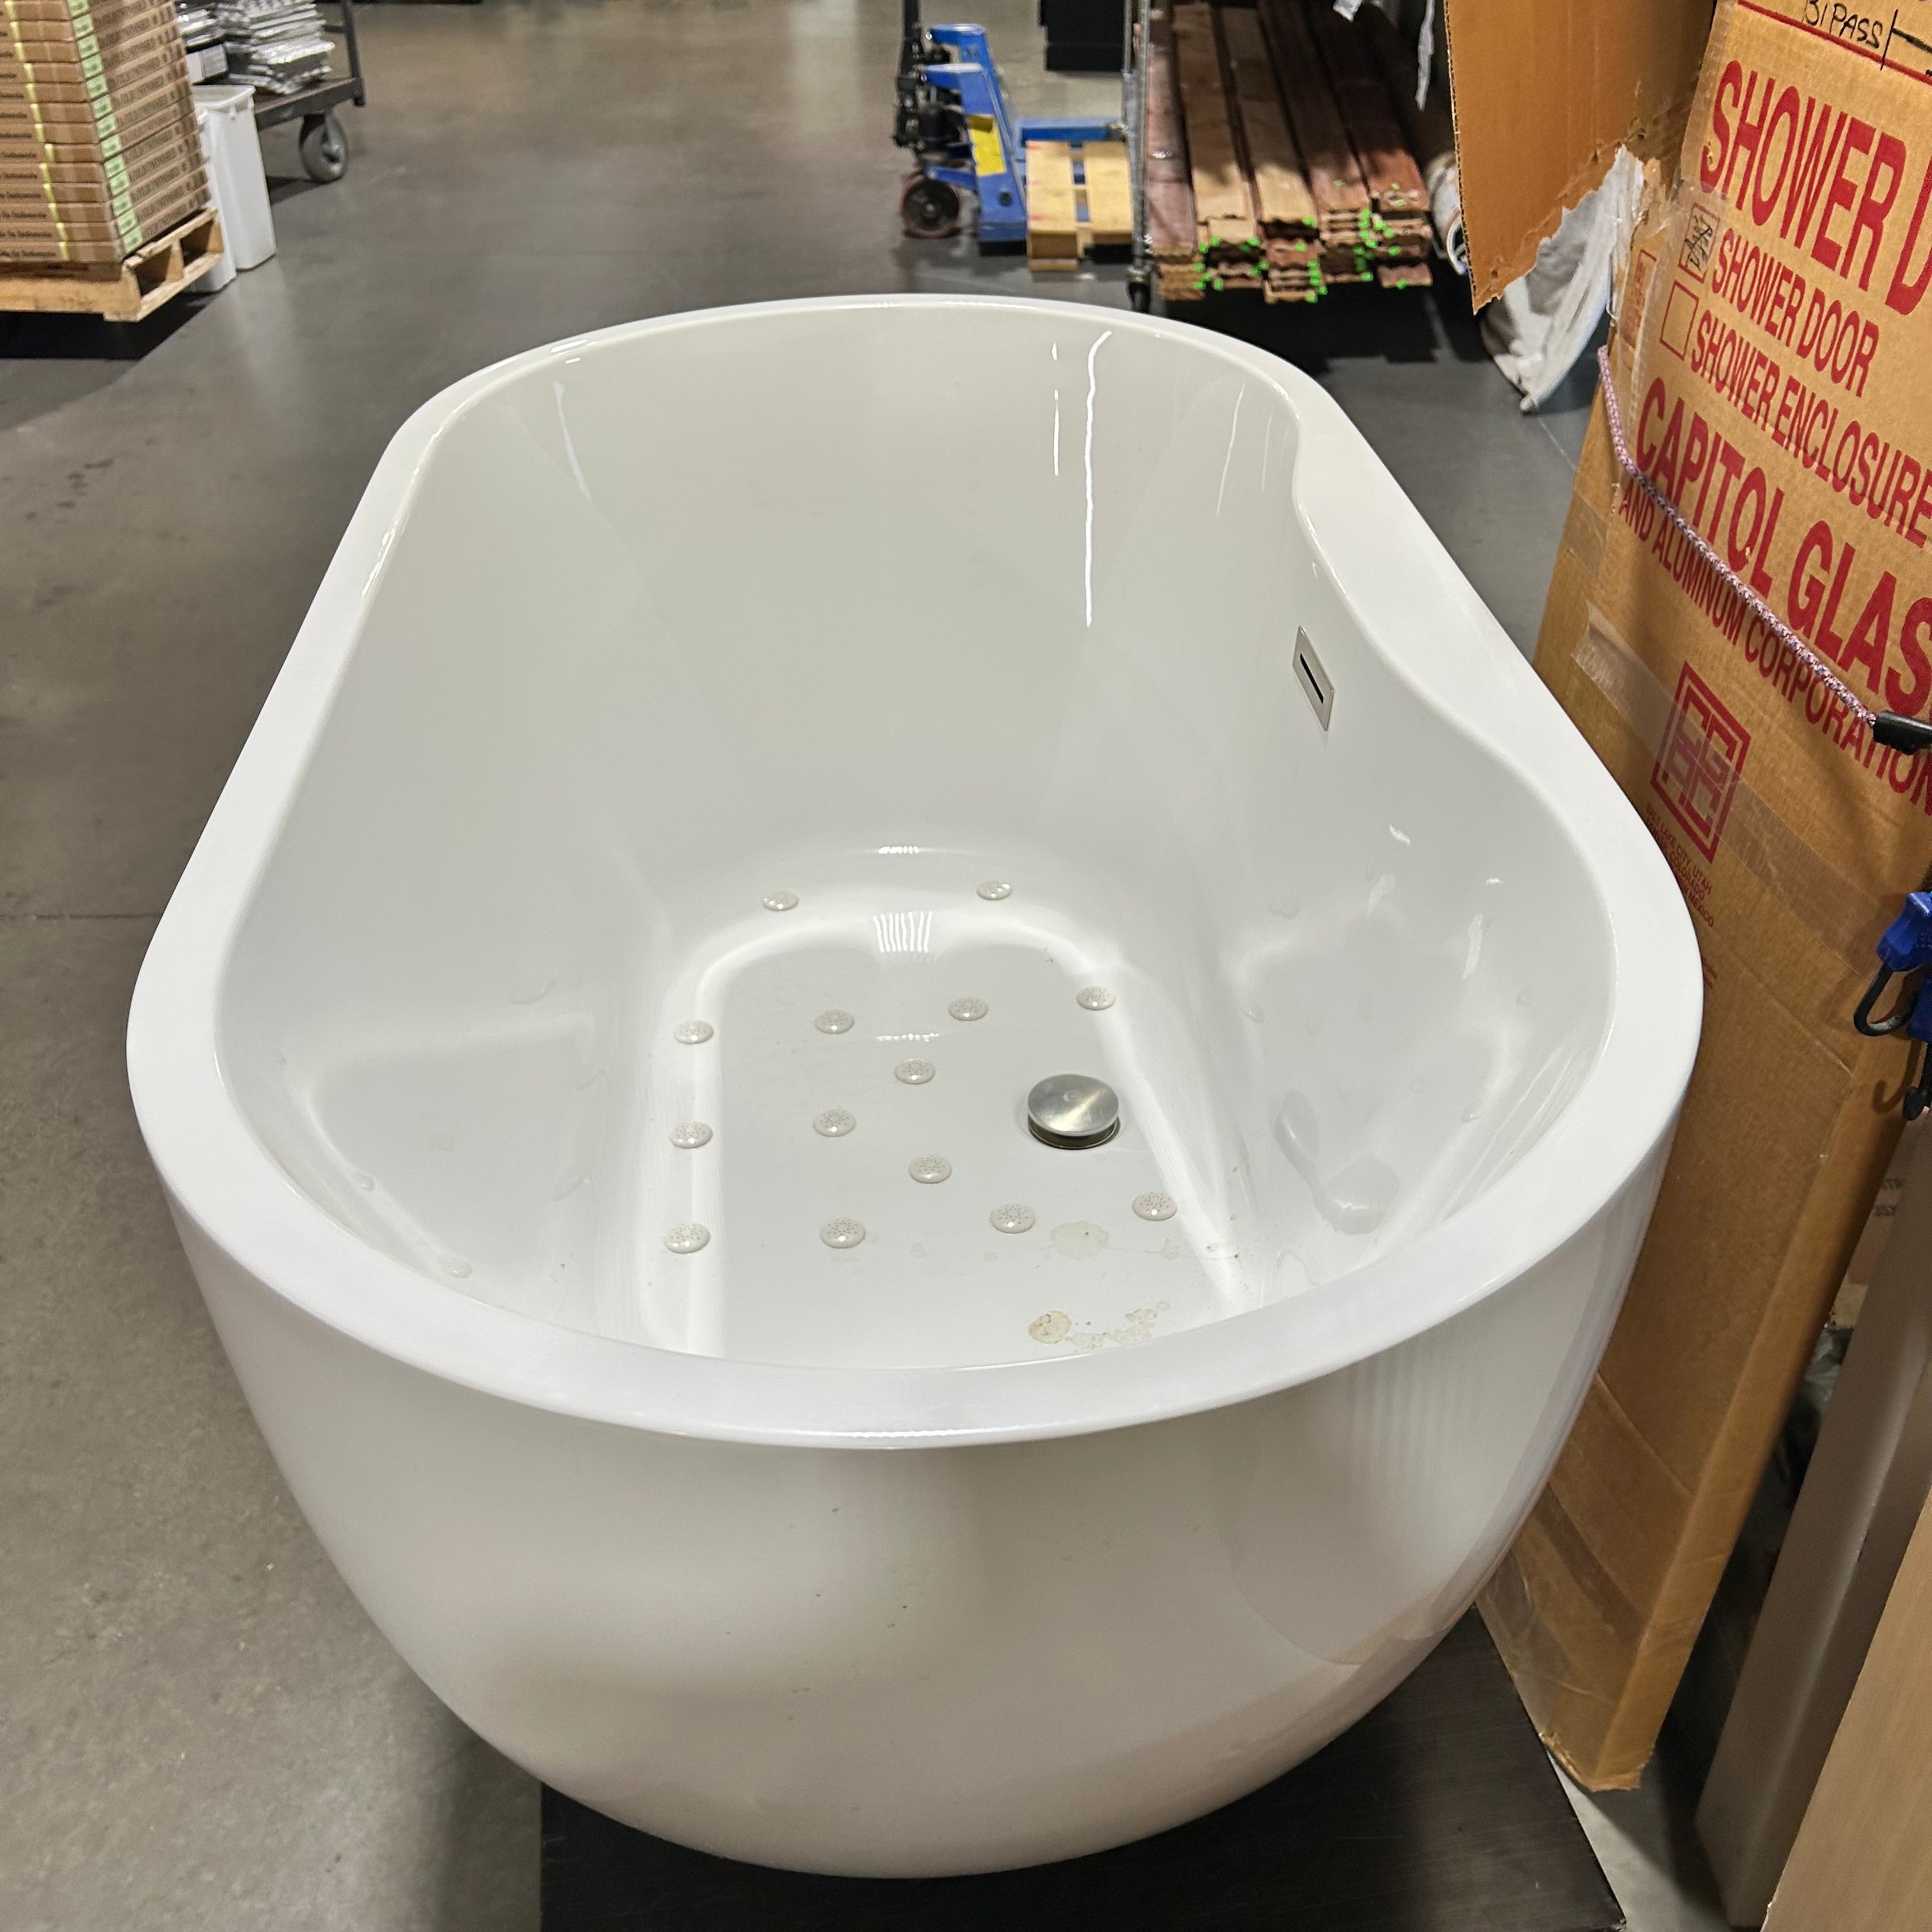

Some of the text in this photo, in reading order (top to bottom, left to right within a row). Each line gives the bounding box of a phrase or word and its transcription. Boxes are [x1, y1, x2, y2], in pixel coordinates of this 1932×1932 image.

[1699, 60, 1906, 292] SHOWER
[1712, 227, 1807, 348] SHOWER
[1795, 287, 1880, 398] DOOR
[1690, 309, 1932, 549] SHOWER ENCLOSURE
[1618, 479, 1656, 543] AND
[1652, 511, 1747, 647] ALUMINUM
[1636, 377, 1932, 718] CAPITOL GLAS
[1669, 851, 1705, 901] COLORADO
[1689, 891, 1714, 928] MEXICO
[1693, 865, 1712, 895] UTAH
